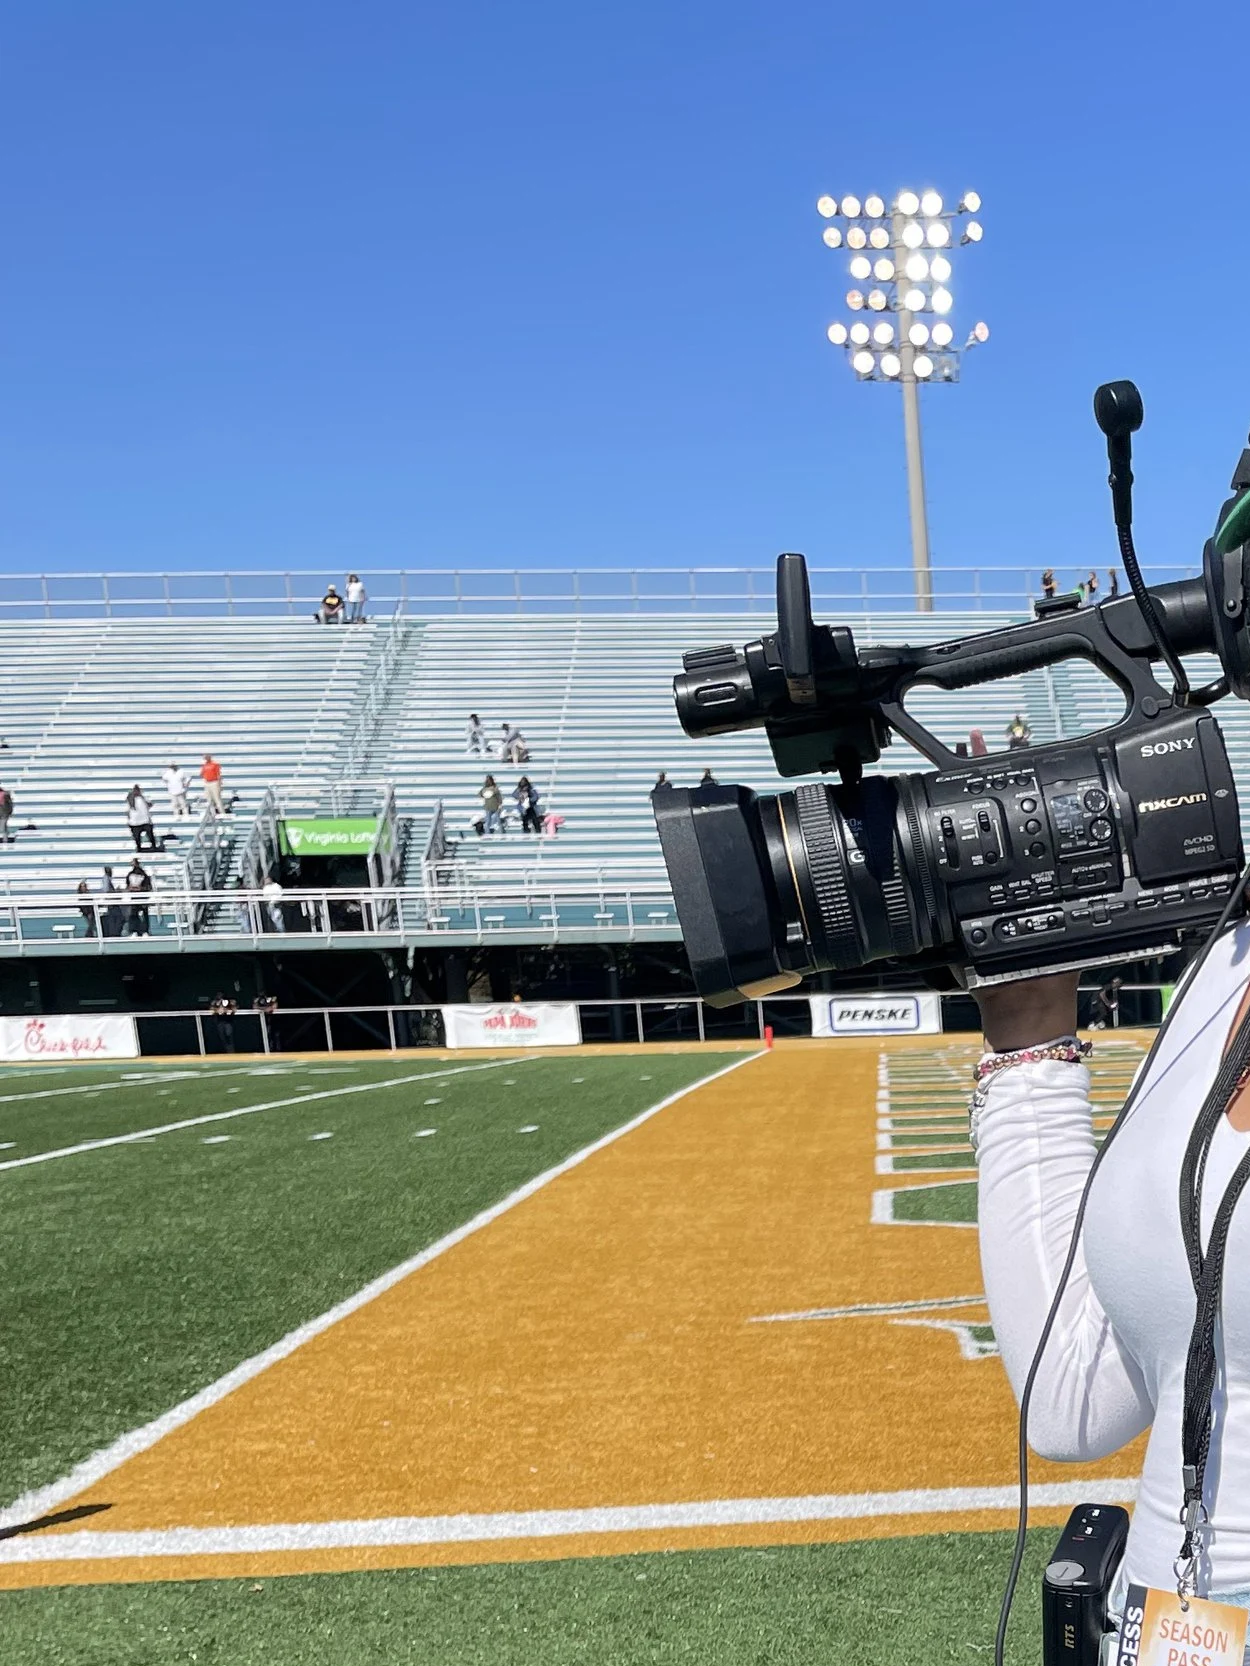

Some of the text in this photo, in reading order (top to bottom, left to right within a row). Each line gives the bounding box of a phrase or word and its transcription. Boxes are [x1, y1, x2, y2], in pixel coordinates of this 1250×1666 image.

[1140, 737, 1195, 758] SONY
[1138, 792, 1207, 814] NXCAM
[304, 831, 347, 846] Virginia
[1183, 834, 1214, 846] AVCHD
[838, 1008, 912, 1021] PENSKE
[1064, 1624, 1075, 1649] RTS
[1159, 1618, 1229, 1653] SEASON
